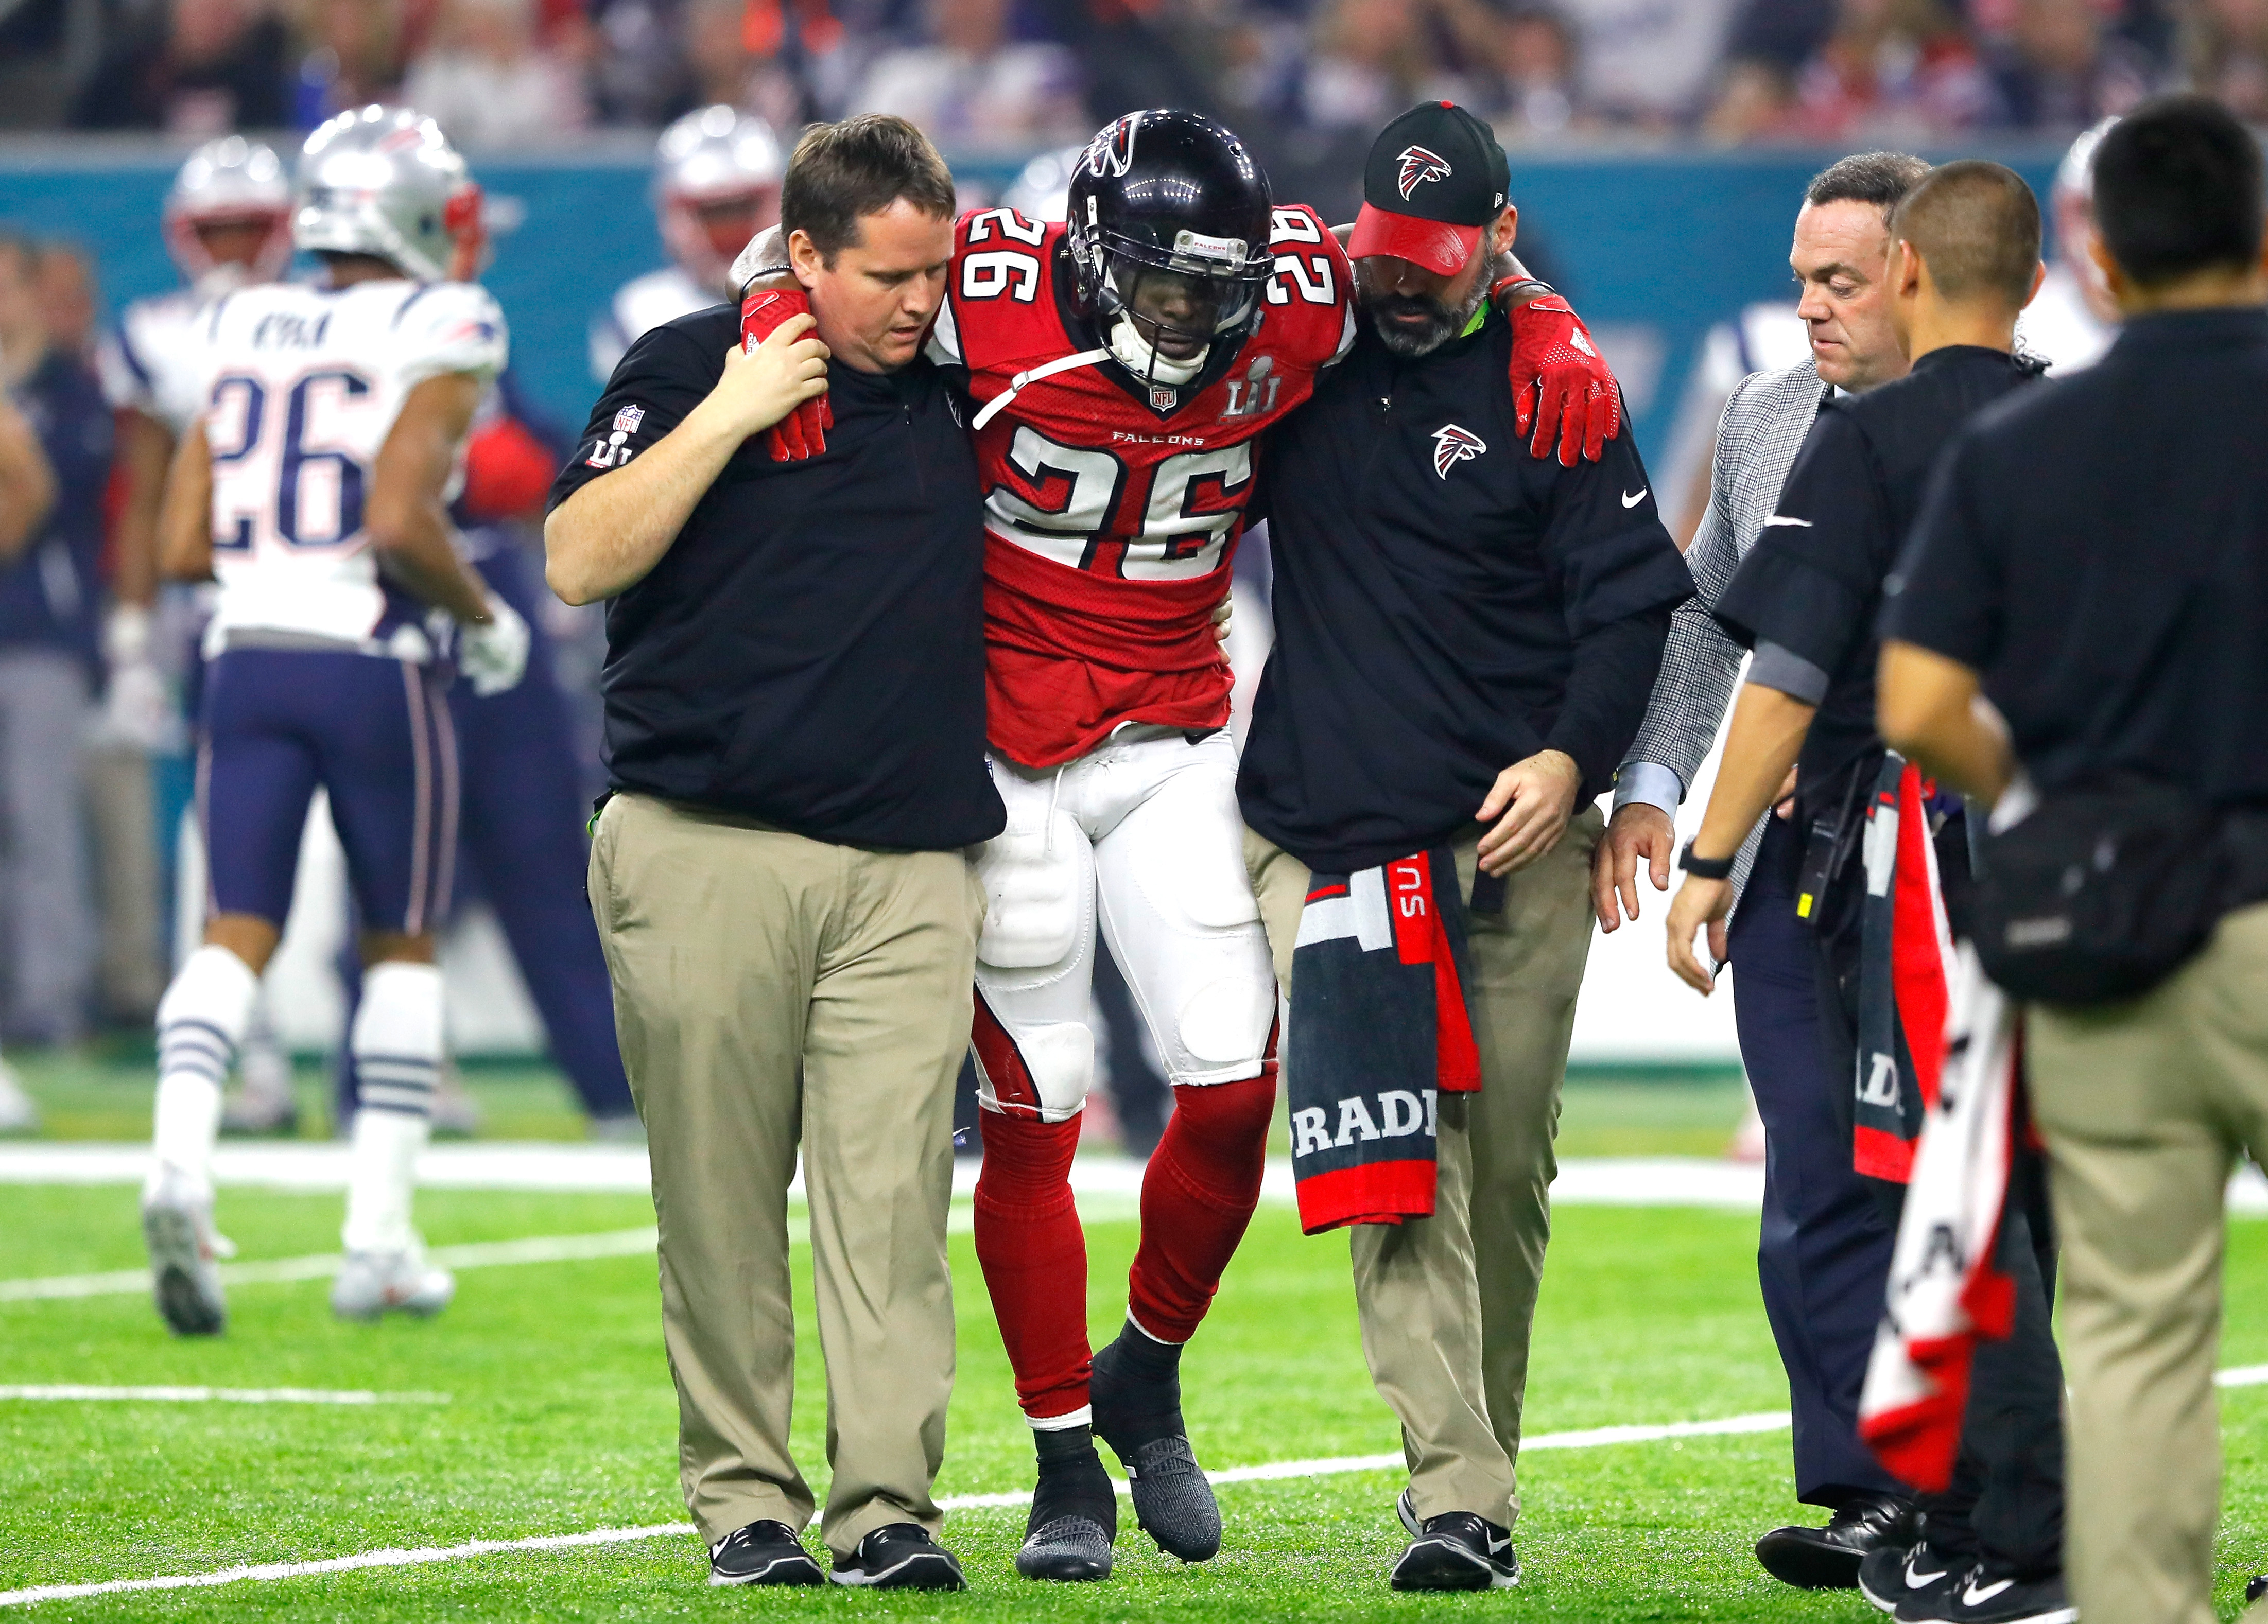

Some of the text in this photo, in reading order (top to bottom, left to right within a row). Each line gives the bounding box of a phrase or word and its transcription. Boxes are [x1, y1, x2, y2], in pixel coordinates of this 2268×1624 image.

[962, 206, 1047, 304] 26
[1194, 242, 1226, 251] FALCONS
[1154, 392, 1173, 406] NFL
[617, 416, 634, 433] NFL
[1112, 431, 1205, 446] FALCONS
[211, 375, 369, 549] 26
[984, 425, 1251, 582] 26
